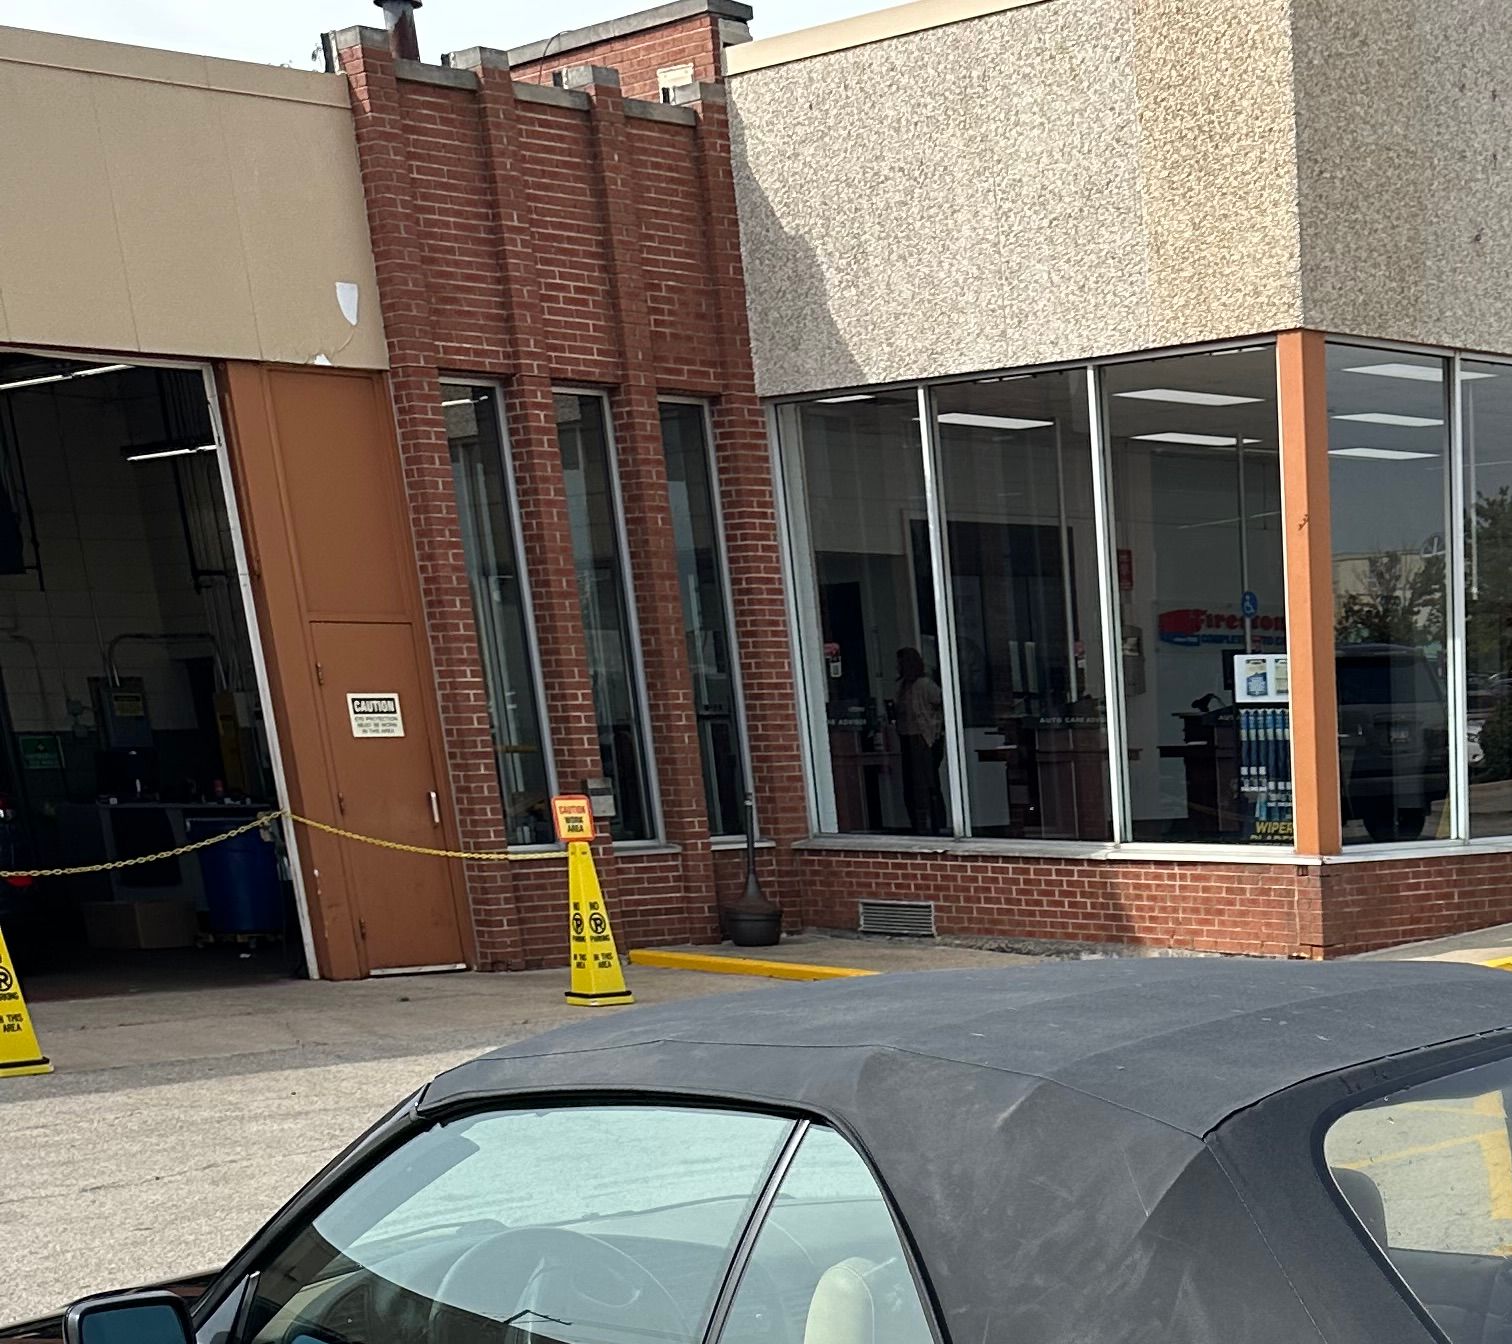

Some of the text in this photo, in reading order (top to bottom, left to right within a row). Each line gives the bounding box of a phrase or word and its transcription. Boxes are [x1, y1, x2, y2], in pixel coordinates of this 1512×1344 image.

[353, 700, 395, 713] CAUTION
[558, 805, 586, 815] CAUTION
[565, 816, 583, 824] WORK
[567, 824, 584, 833] AREA
[589, 901, 599, 911] NO
[601, 952, 613, 961] THIS
[598, 960, 612, 969] AREA
[6, 1013, 24, 1023] THIS
[3, 1023, 23, 1033] AREA
